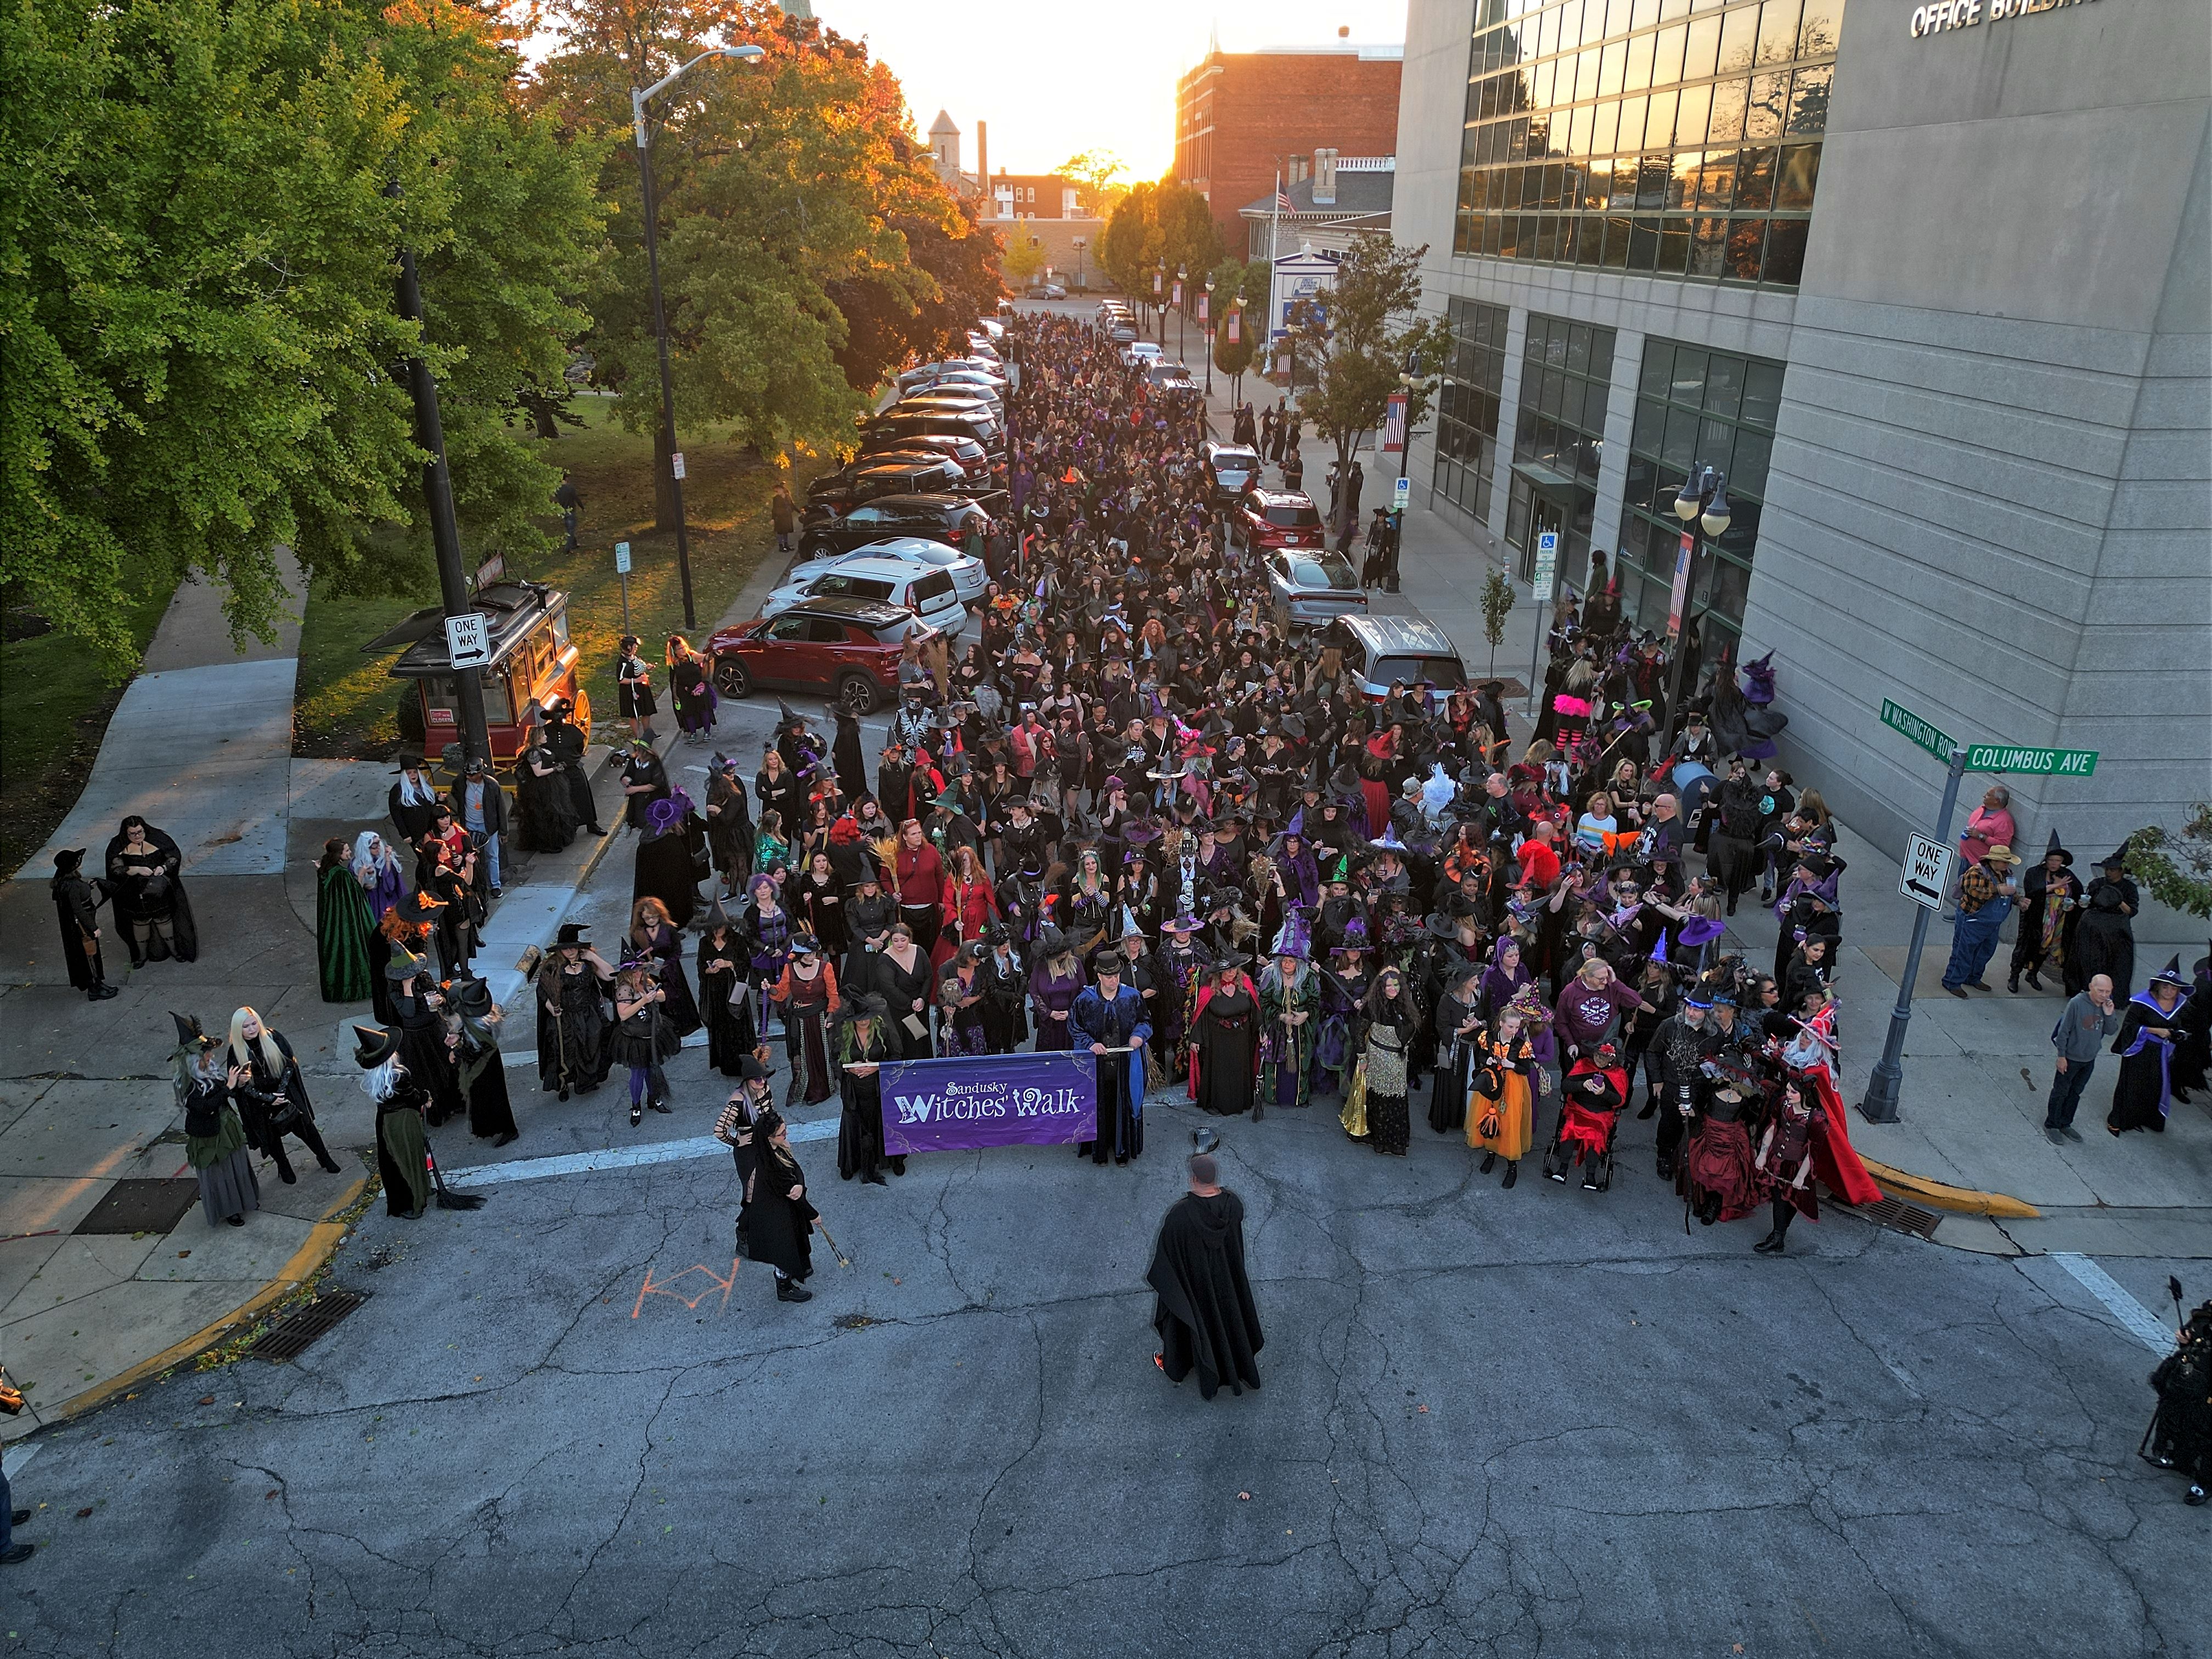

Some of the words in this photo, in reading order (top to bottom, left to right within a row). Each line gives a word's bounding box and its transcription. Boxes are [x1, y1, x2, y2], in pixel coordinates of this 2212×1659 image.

[1911, 0, 1982, 38] OFFICE
[455, 618, 477, 633] ONE
[457, 633, 477, 647] WAY
[1884, 701, 1892, 720] W
[1892, 706, 1937, 749] WASHINGTON
[1937, 735, 1955, 761] ROW
[1972, 748, 2055, 771] COLUMBUS
[2059, 753, 2091, 772] AVE
[1917, 842, 1943, 865] ONE
[1915, 859, 1938, 881] WAY
[945, 1082, 1007, 1096] Sandusky
[894, 1094, 1009, 1124] Witches'
[1012, 1088, 1080, 1117] Walk
